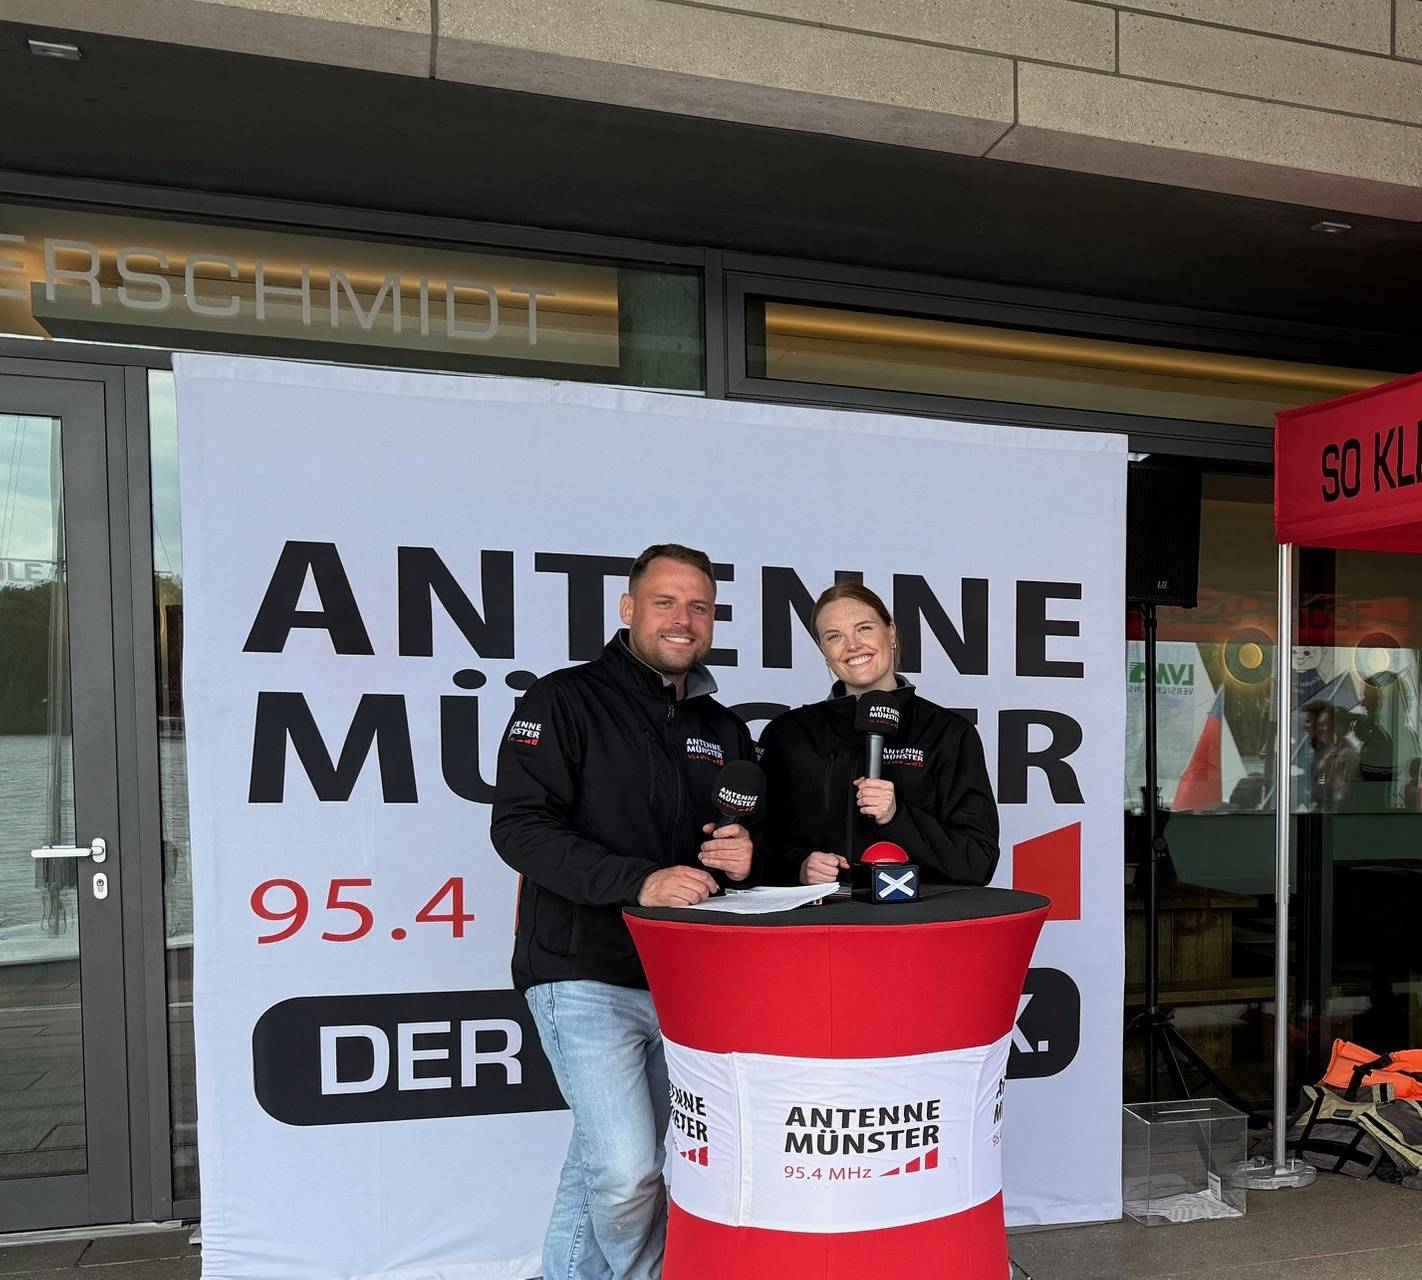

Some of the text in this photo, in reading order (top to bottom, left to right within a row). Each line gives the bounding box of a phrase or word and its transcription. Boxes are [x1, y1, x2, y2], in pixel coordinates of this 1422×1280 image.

[1322, 439, 1360, 502] SO
[250, 876, 475, 944] 95.4
[320, 1018, 523, 1096] DER
[785, 1099, 941, 1129] ANTENNE
[784, 1123, 940, 1156] MÜNSTER
[784, 1165, 872, 1180] 95.4 MHz
